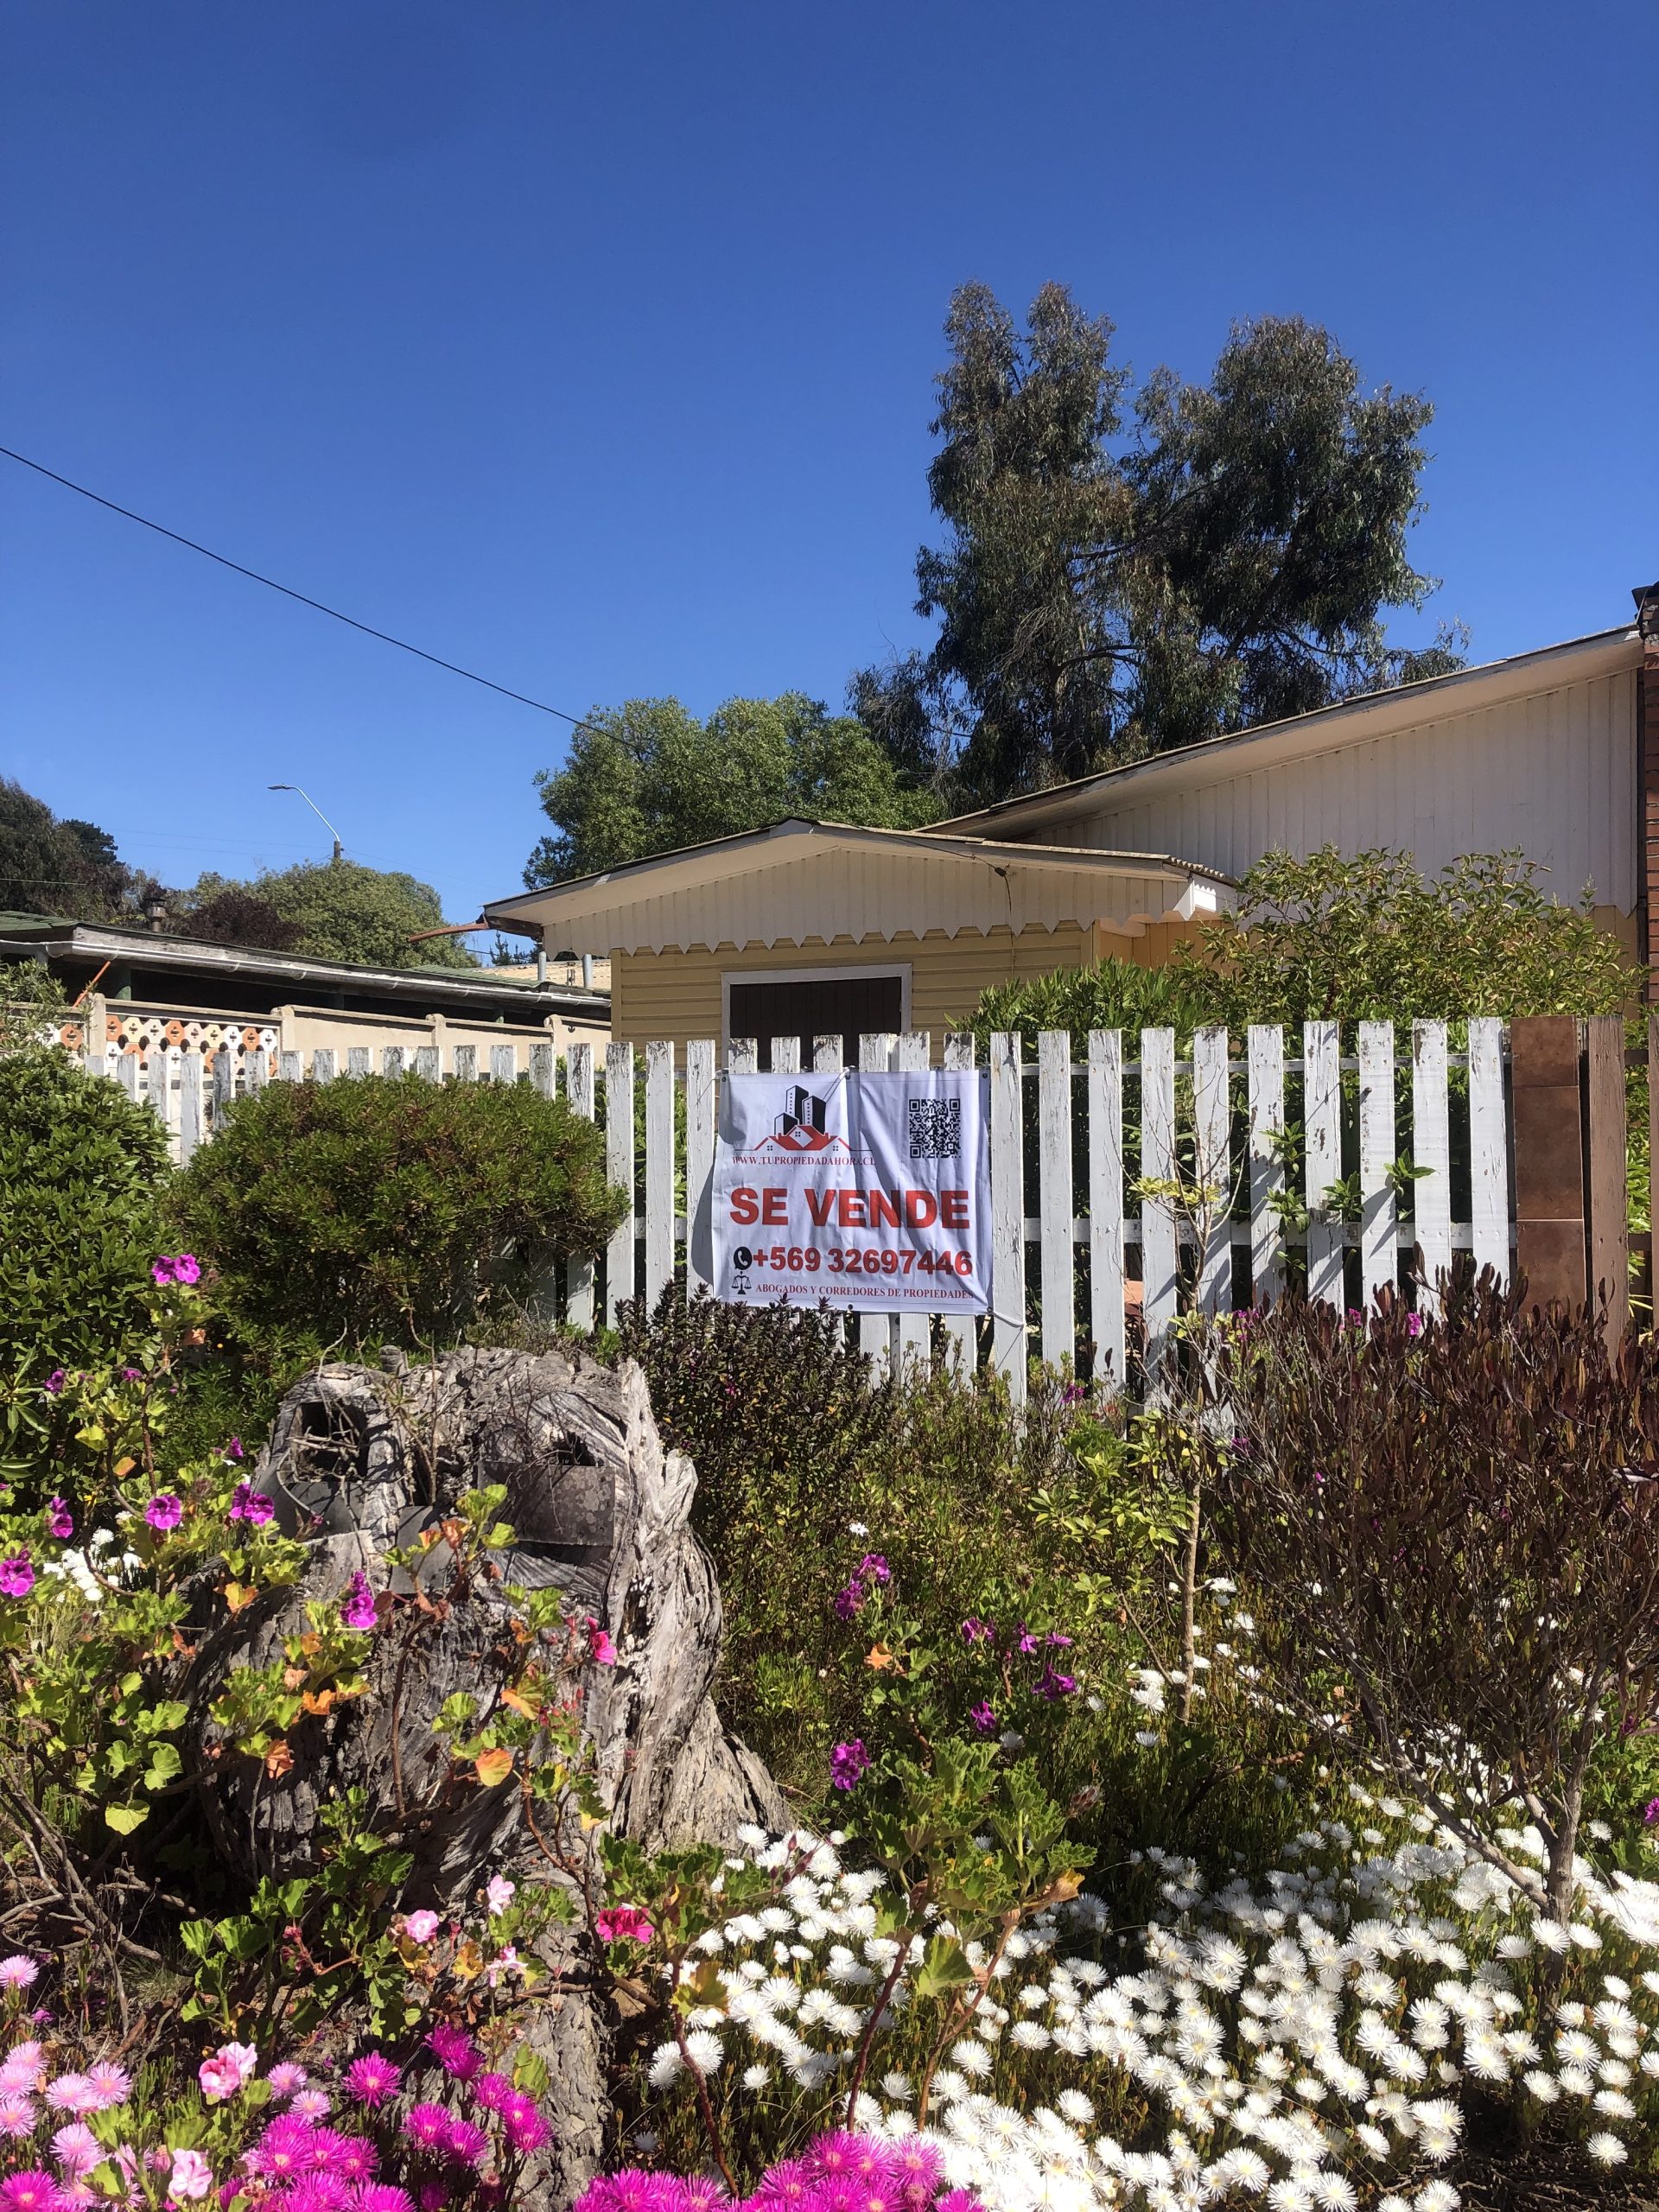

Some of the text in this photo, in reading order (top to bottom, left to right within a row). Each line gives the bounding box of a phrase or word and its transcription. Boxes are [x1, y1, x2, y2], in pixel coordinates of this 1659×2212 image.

[732, 1155, 876, 1166] WWW.TUPROPIEDADAHORA.CL
[729, 1187, 970, 1230] SE VENDE
[753, 1246, 974, 1276] +569 32697446
[755, 1283, 974, 1300] ABOGADOS Y CORREDORES DE PROPIEDADES
